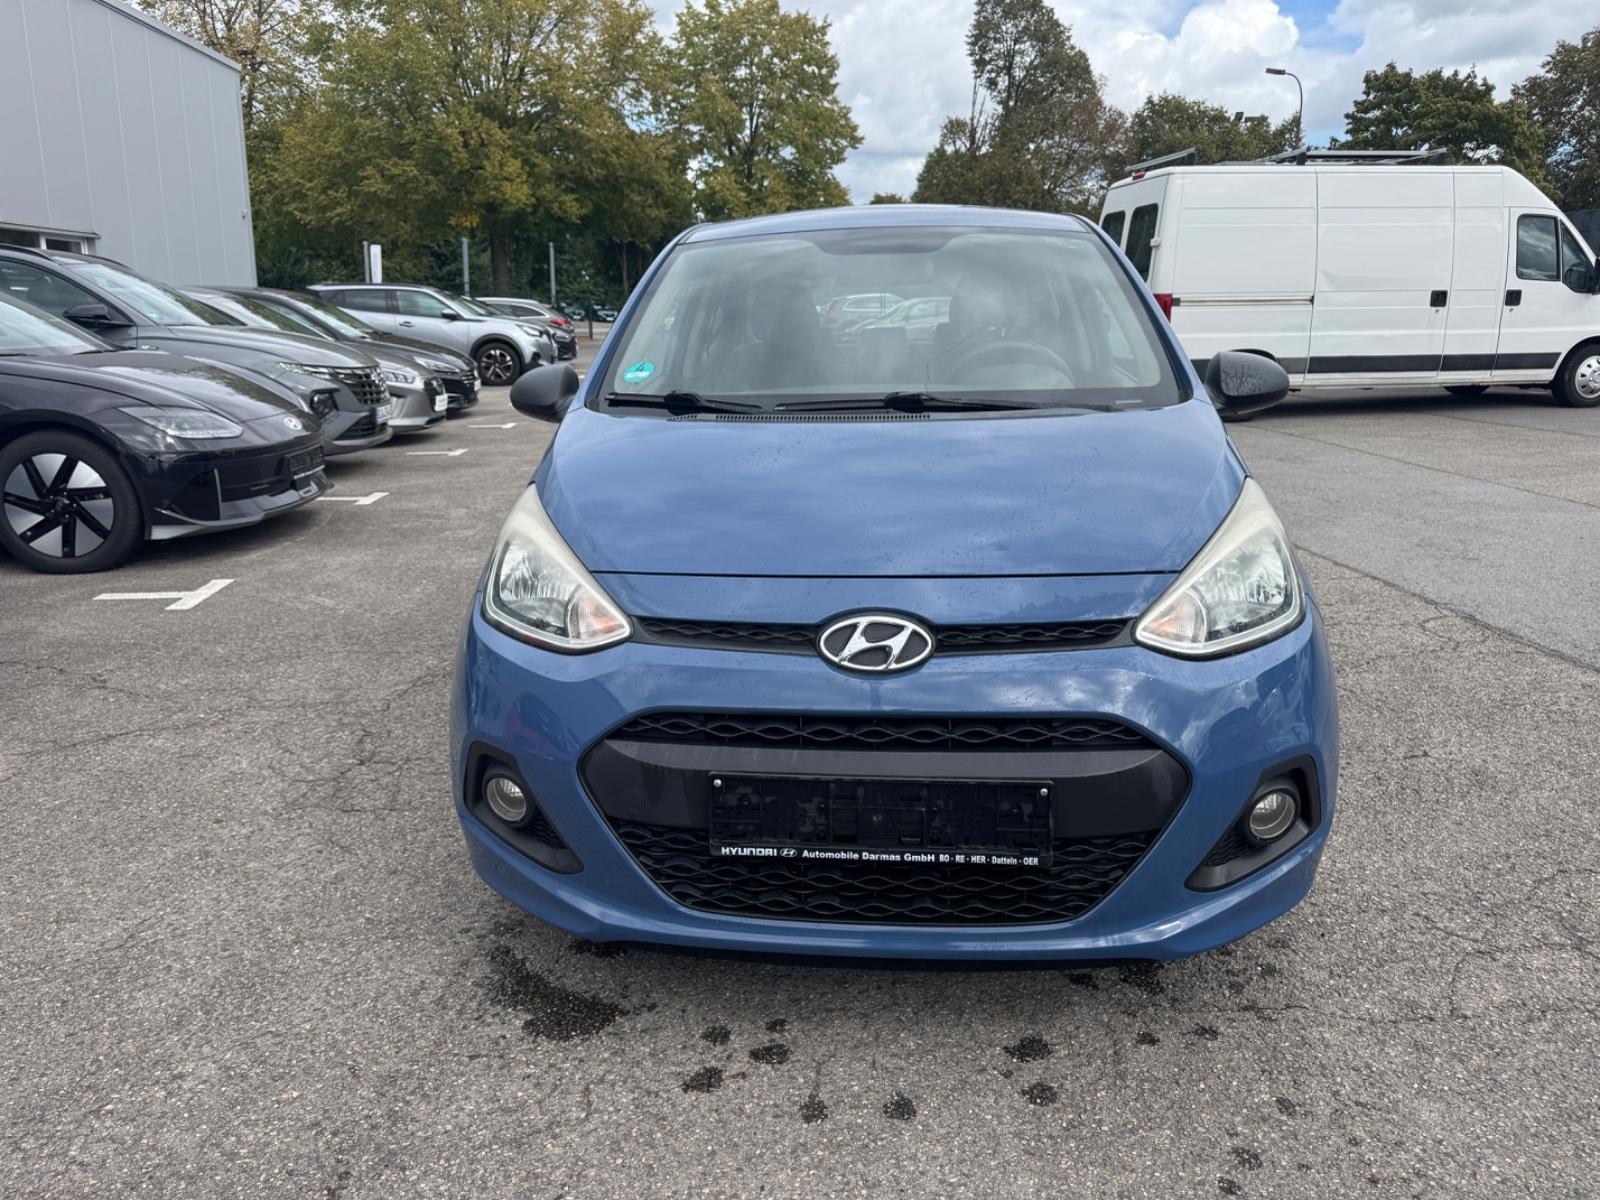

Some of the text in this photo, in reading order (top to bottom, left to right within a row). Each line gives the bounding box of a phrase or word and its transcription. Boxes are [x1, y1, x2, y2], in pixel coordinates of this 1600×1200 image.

[721, 847, 777, 857] HYUNDAI
[802, 849, 859, 860] Automobile
[862, 851, 901, 861] Darmas
[904, 853, 935, 862] GmbH
[939, 854, 950, 862] BO
[955, 855, 965, 863] RE
[971, 855, 986, 864] HER
[1023, 857, 1039, 866] OER
